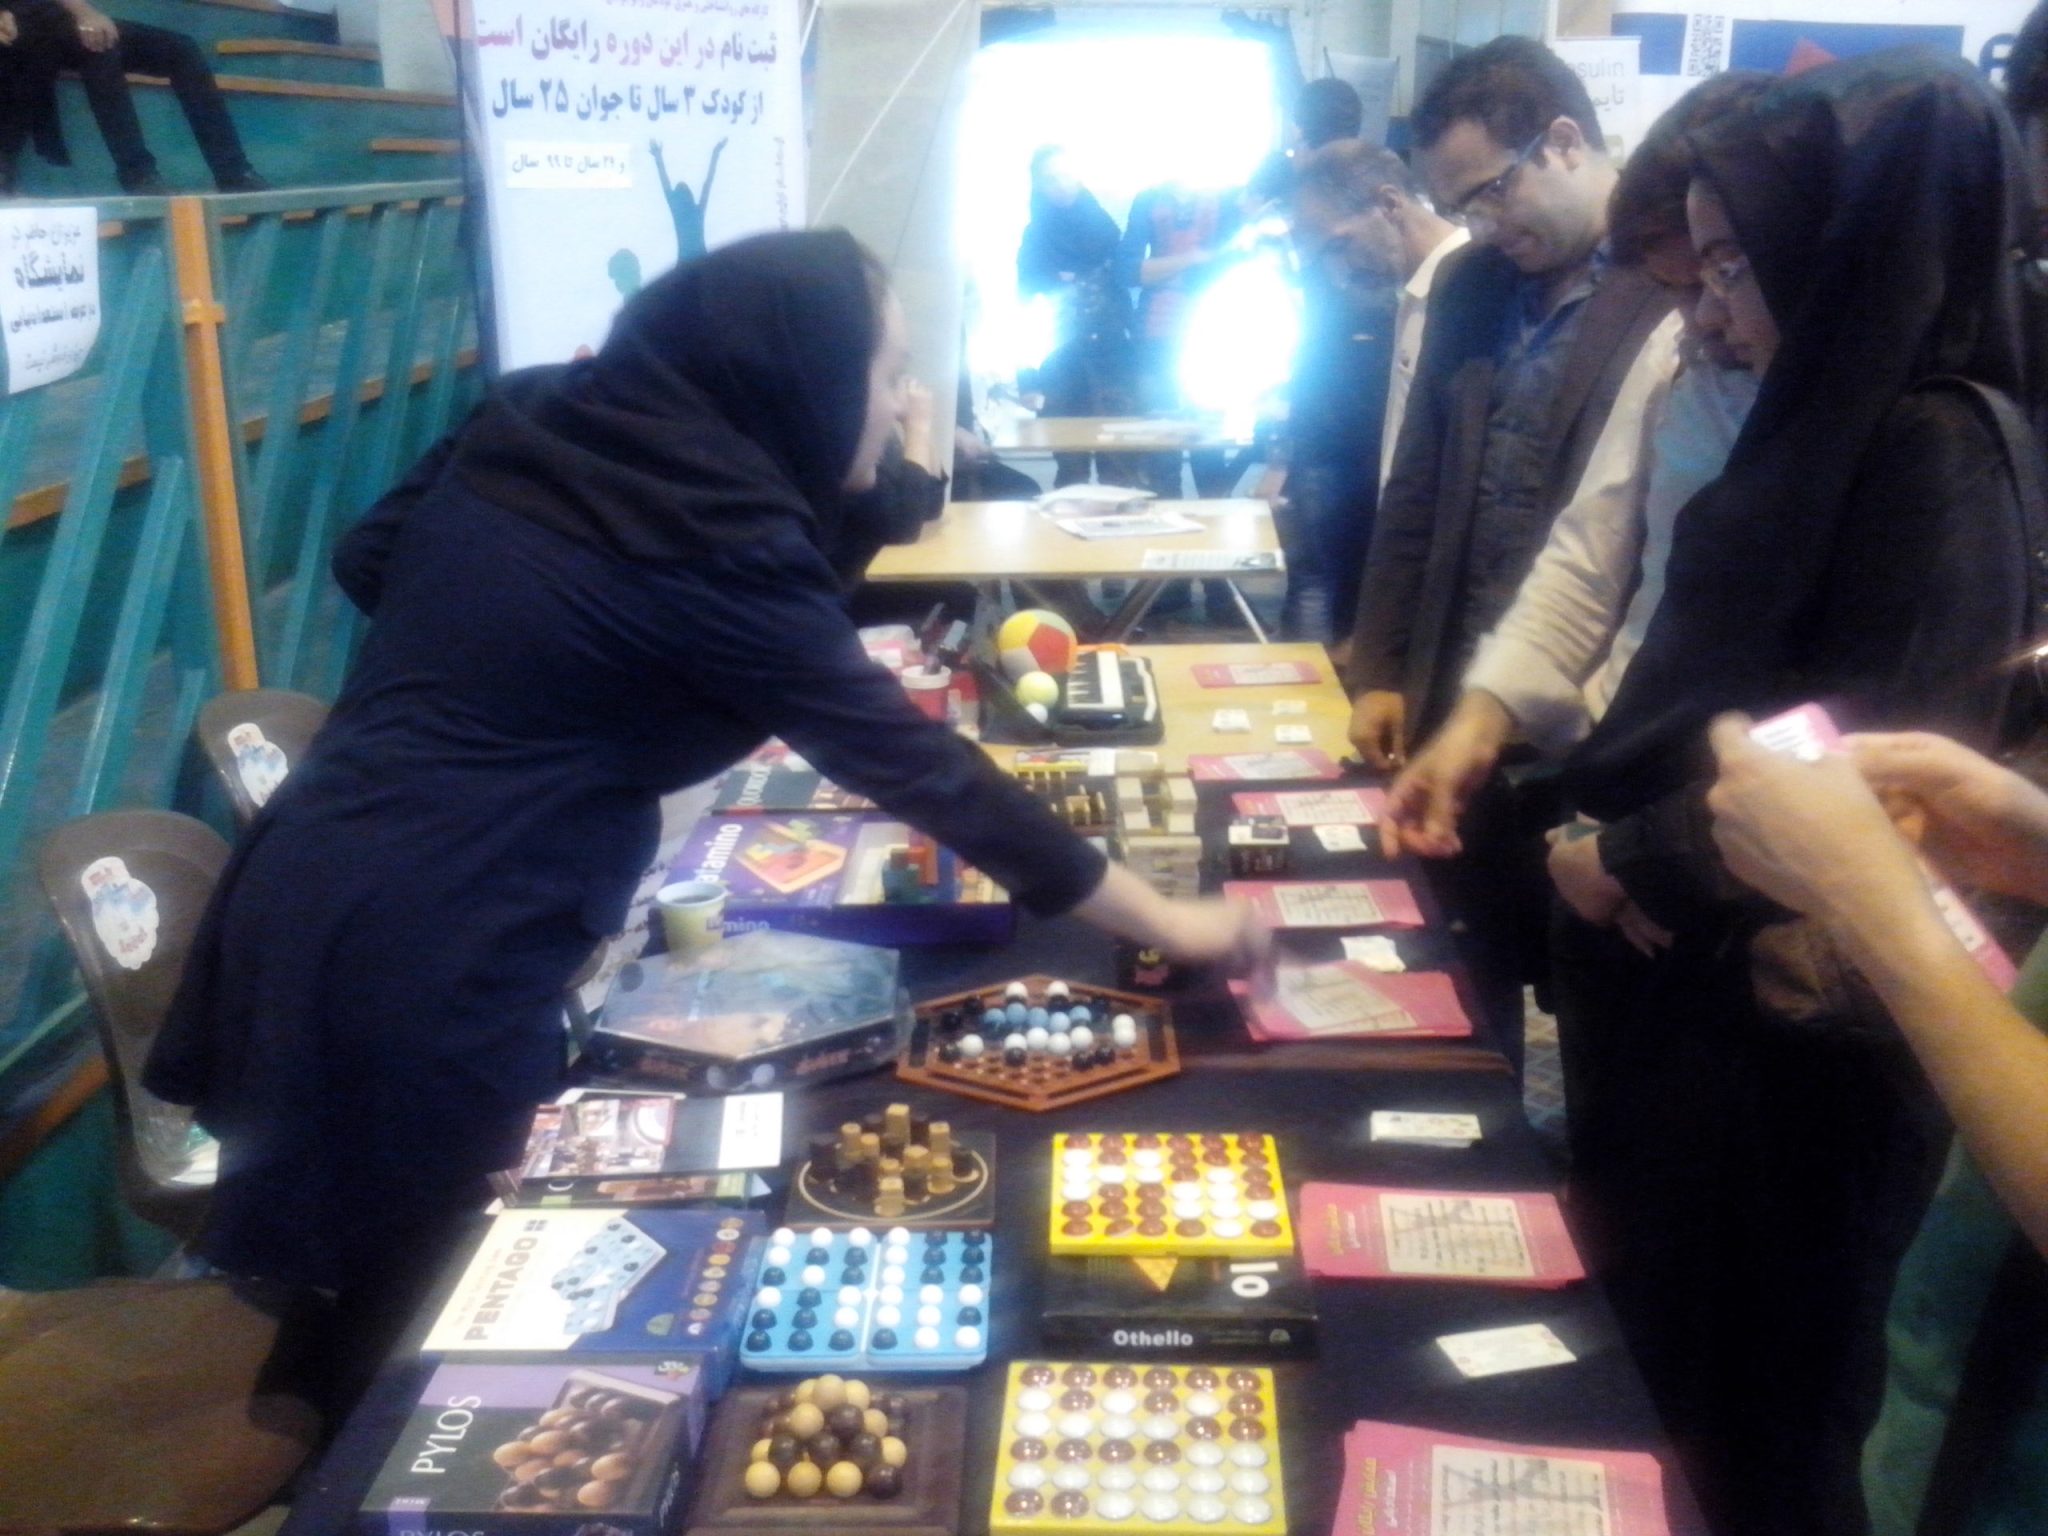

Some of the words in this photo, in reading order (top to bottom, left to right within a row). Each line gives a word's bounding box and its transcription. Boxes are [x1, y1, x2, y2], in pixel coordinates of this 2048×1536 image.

[478, 13, 523, 47] است
[531, 16, 600, 63] رایگان
[659, 27, 689, 67] این
[606, 31, 653, 66] دوره
[694, 36, 715, 69] در
[721, 31, 743, 70] نام
[747, 32, 777, 71] ثبت
[492, 78, 534, 118] سال
[540, 78, 569, 112] ۲۵
[576, 84, 623, 121] جوان
[629, 84, 642, 112] تا
[647, 84, 679, 121] سال
[683, 84, 696, 116] ۳
[702, 88, 747, 124] کودک
[751, 90, 764, 125] از
[512, 153, 539, 173] سال
[577, 154, 600, 174] سال
[14, 251, 84, 291] نمایشگاه
[693, 824, 743, 882] atamino
[463, 1237, 539, 1340] PENTAGO
[1112, 1328, 1194, 1346] Othello
[410, 1395, 482, 1474] PYLOS
